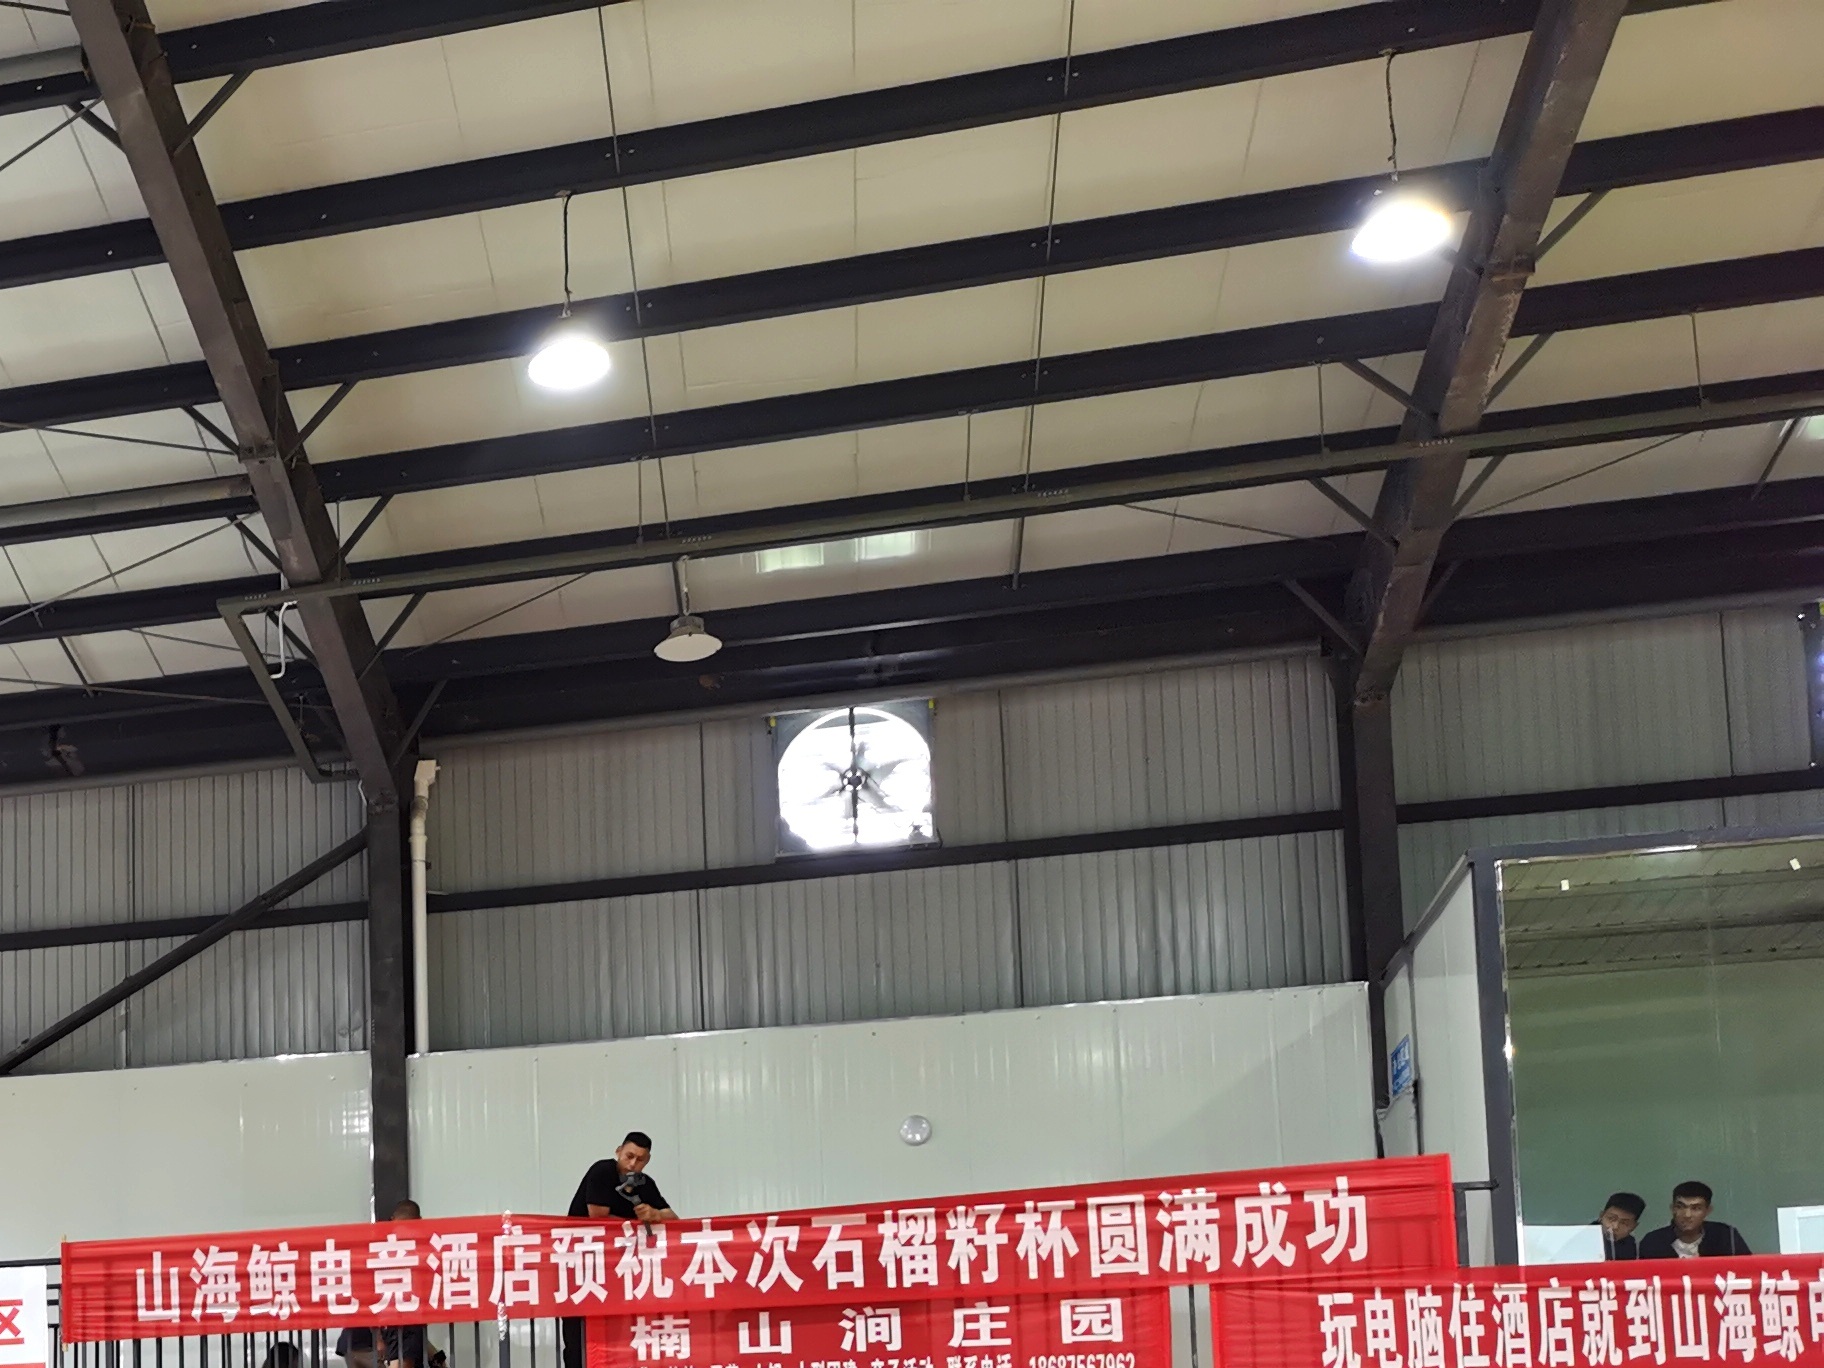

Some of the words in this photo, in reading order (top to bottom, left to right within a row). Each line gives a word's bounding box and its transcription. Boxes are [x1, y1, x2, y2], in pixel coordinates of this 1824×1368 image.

[133, 1175, 1369, 1326] 山海鲸电竞酒店预祝本次石榴籽杯圆满成功
